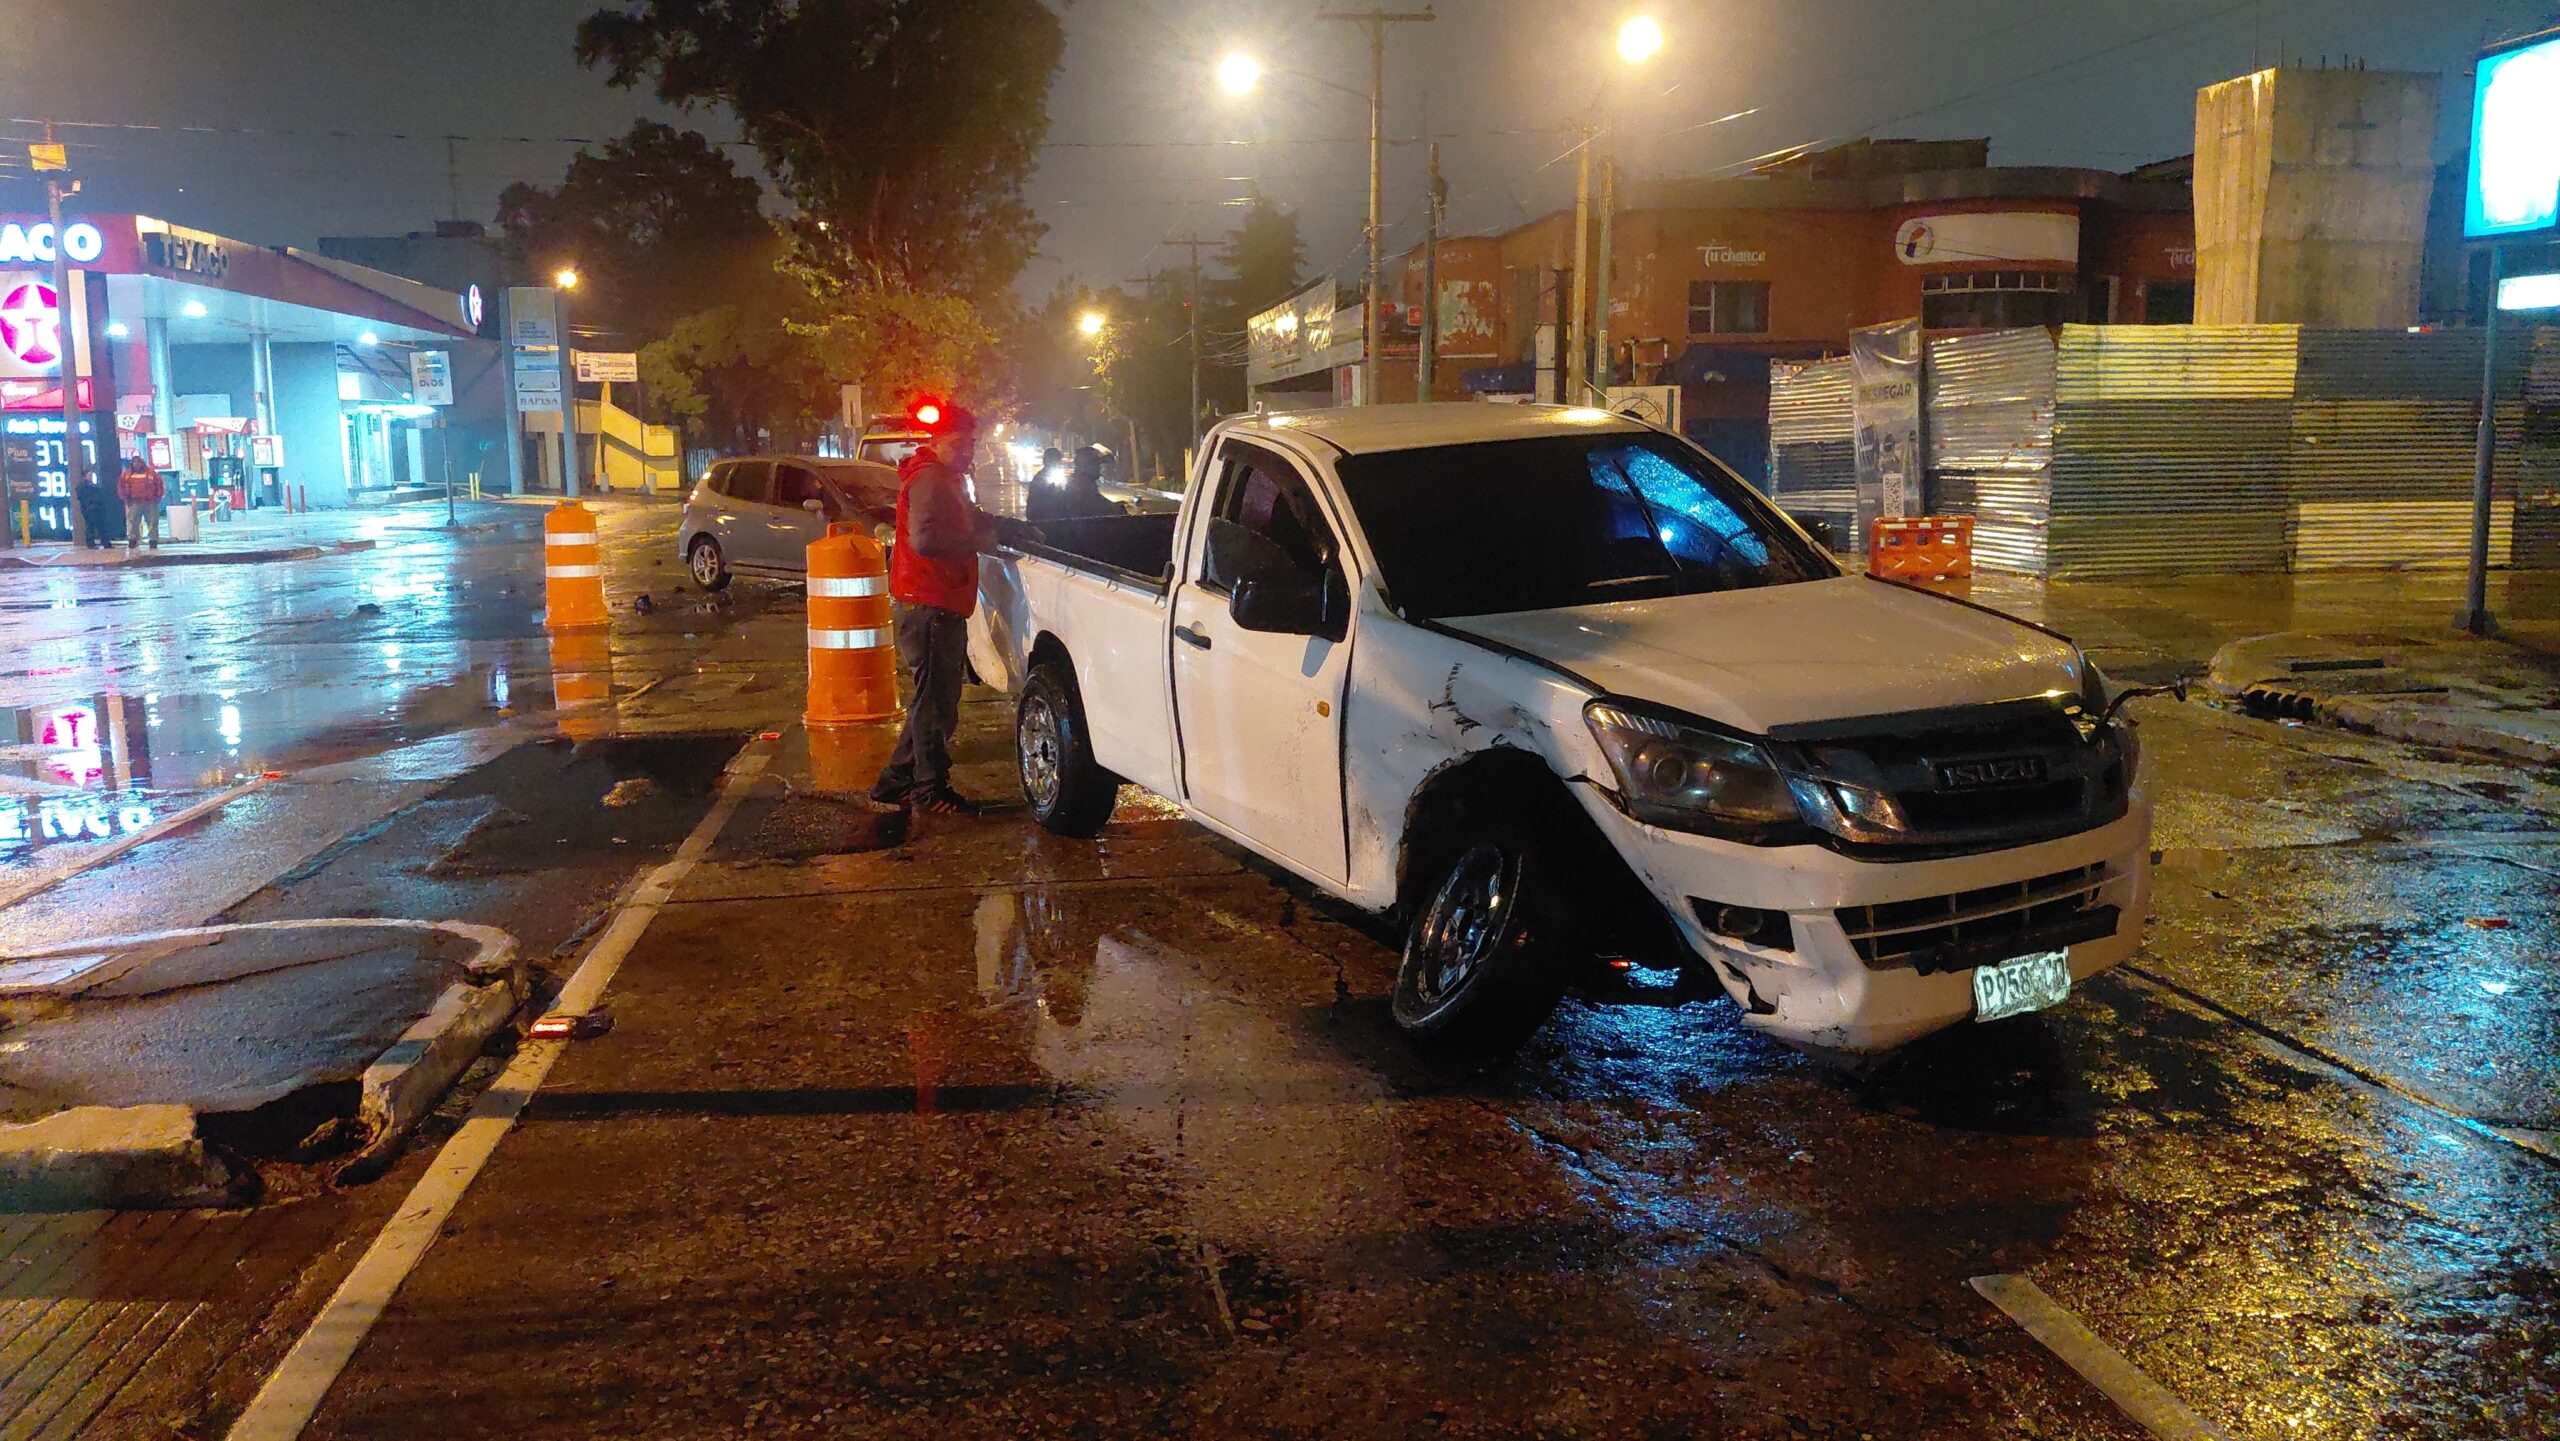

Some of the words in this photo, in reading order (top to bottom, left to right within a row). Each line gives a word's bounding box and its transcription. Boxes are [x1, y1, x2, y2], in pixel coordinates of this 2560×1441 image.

[160, 232, 230, 276] TEXACO
[1721, 247, 1766, 262] chance
[35, 440, 96, 466] 37.7
[1943, 759, 2048, 786] ISUZU
